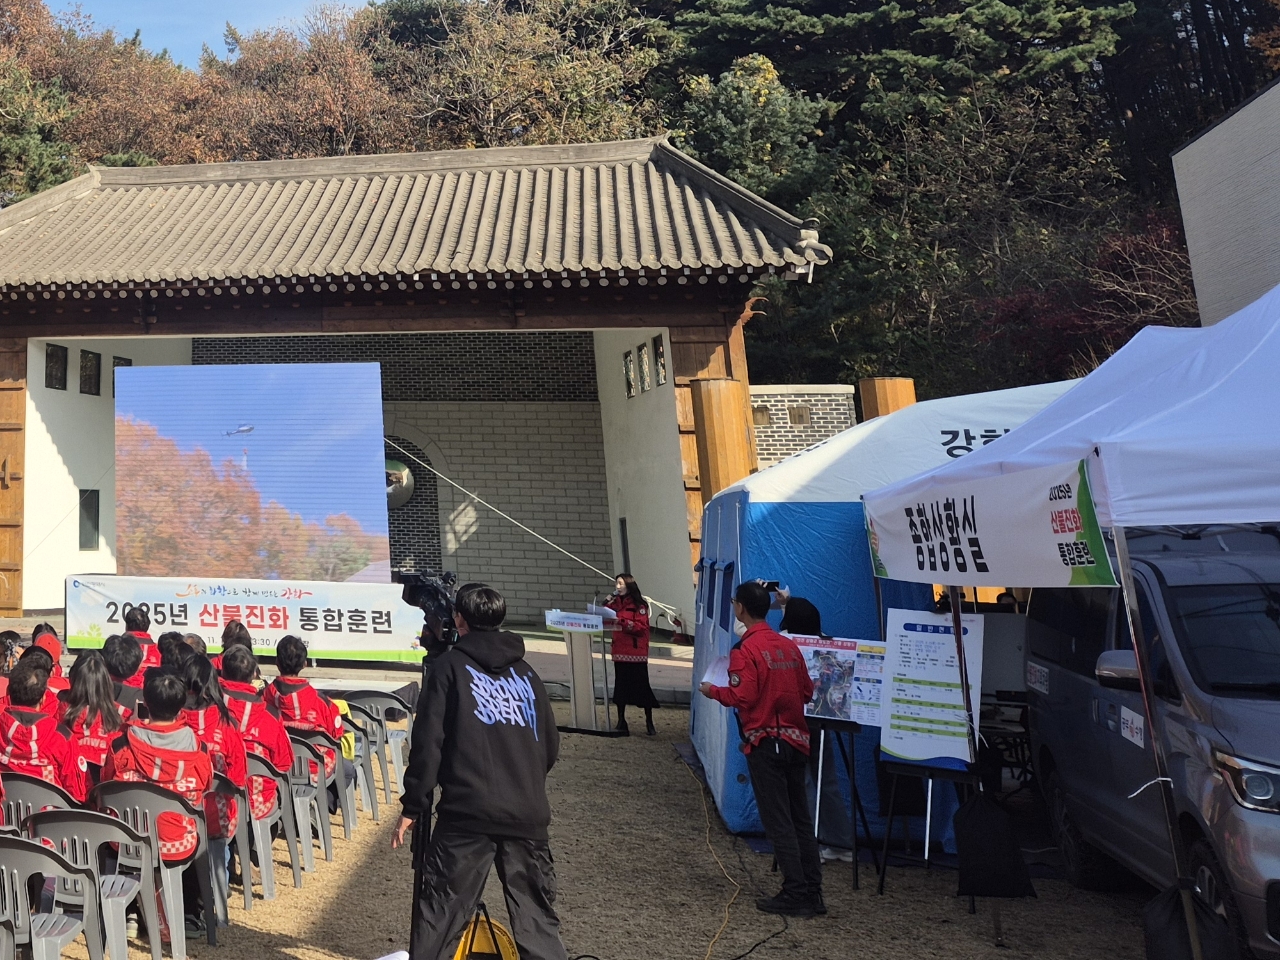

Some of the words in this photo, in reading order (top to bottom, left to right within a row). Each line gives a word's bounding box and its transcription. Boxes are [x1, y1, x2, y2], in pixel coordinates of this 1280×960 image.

[1049, 483, 1073, 501] 2025년
[904, 494, 990, 573] 종합상황실
[1050, 507, 1084, 534] 산불진화
[1057, 541, 1096, 567] 통합훈련
[280, 587, 313, 600] 강화
[198, 603, 290, 630] 산불진화
[298, 606, 393, 635] 통합훈련
[472, 689, 539, 742] BREATH
